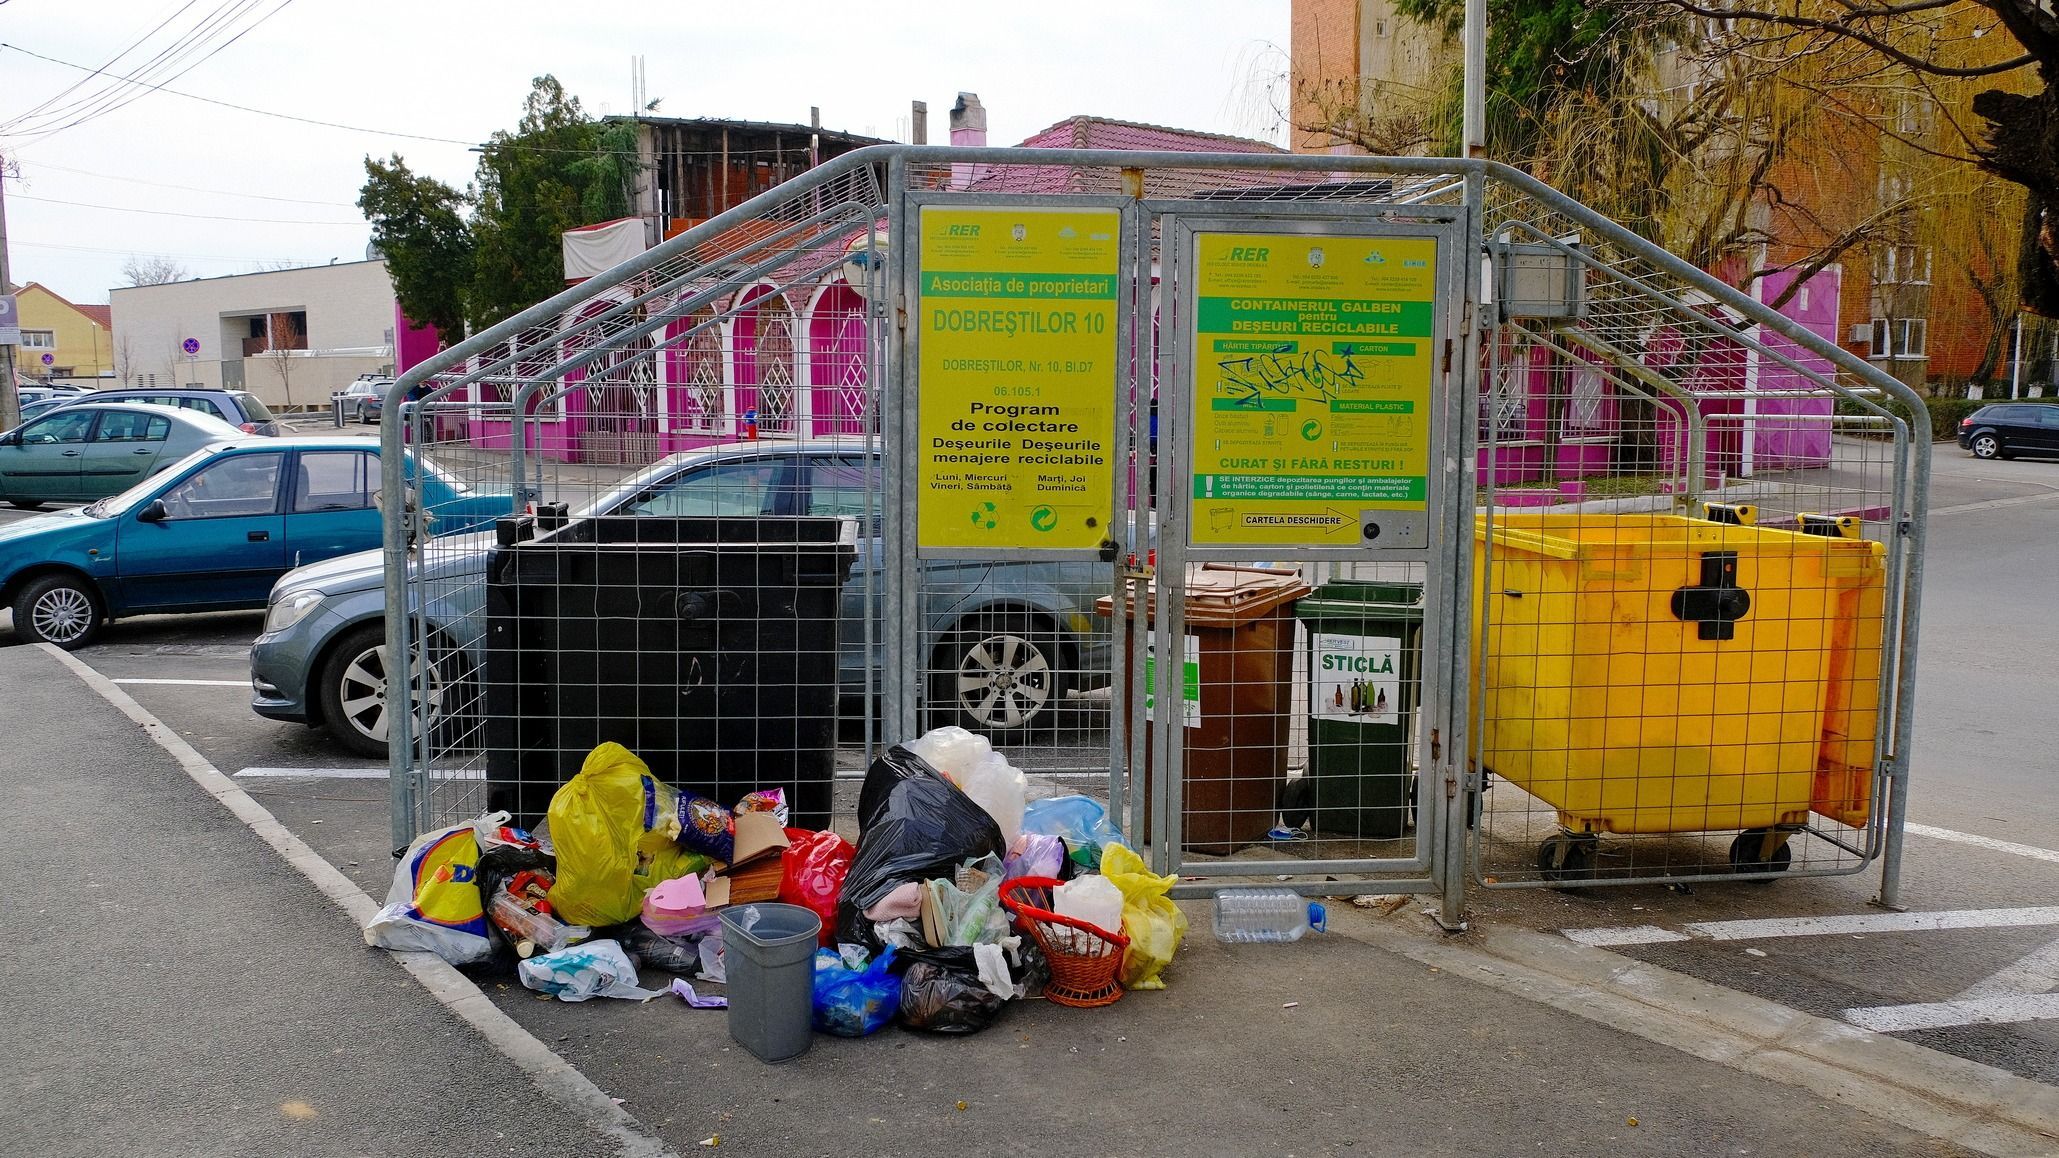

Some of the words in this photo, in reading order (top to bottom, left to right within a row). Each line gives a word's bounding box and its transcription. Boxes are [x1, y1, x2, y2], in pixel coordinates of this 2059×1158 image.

[949, 224, 980, 236] RER
[1231, 247, 1270, 262] RER
[1007, 278, 1024, 292] de
[1030, 279, 1108, 295] proprietari
[1231, 300, 1337, 312] CONTAINERUL
[1342, 302, 1401, 313] GALBEN
[1084, 312, 1105, 334] 10
[1298, 312, 1337, 322] pentru
[1302, 322, 1398, 334] RECICLABILE
[1030, 361, 1043, 372] Nr.
[1047, 361, 1062, 373] 10,
[994, 386, 1040, 397] 06.105.1
[970, 402, 1060, 418] Program
[951, 420, 975, 431] de
[982, 420, 1079, 433] colectare
[933, 453, 1010, 466] menajere
[1018, 454, 1104, 465] reciclabile
[1220, 458, 1268, 469] CURAT
[1292, 457, 1328, 470] FĂRĂ
[1333, 459, 1395, 470] RESTURI
[936, 474, 961, 482] Luni,
[1277, 476, 1321, 484] depozitarea
[1323, 477, 1356, 485] pungilor
[931, 482, 963, 491] Vineri,
[967, 482, 1012, 491] Sâmbătă
[1037, 483, 1086, 491] Duminică
[1245, 516, 1285, 524] CARTELA
[1287, 516, 1341, 525] DESCHIDERE
[1322, 653, 1394, 674] STICLĂ
